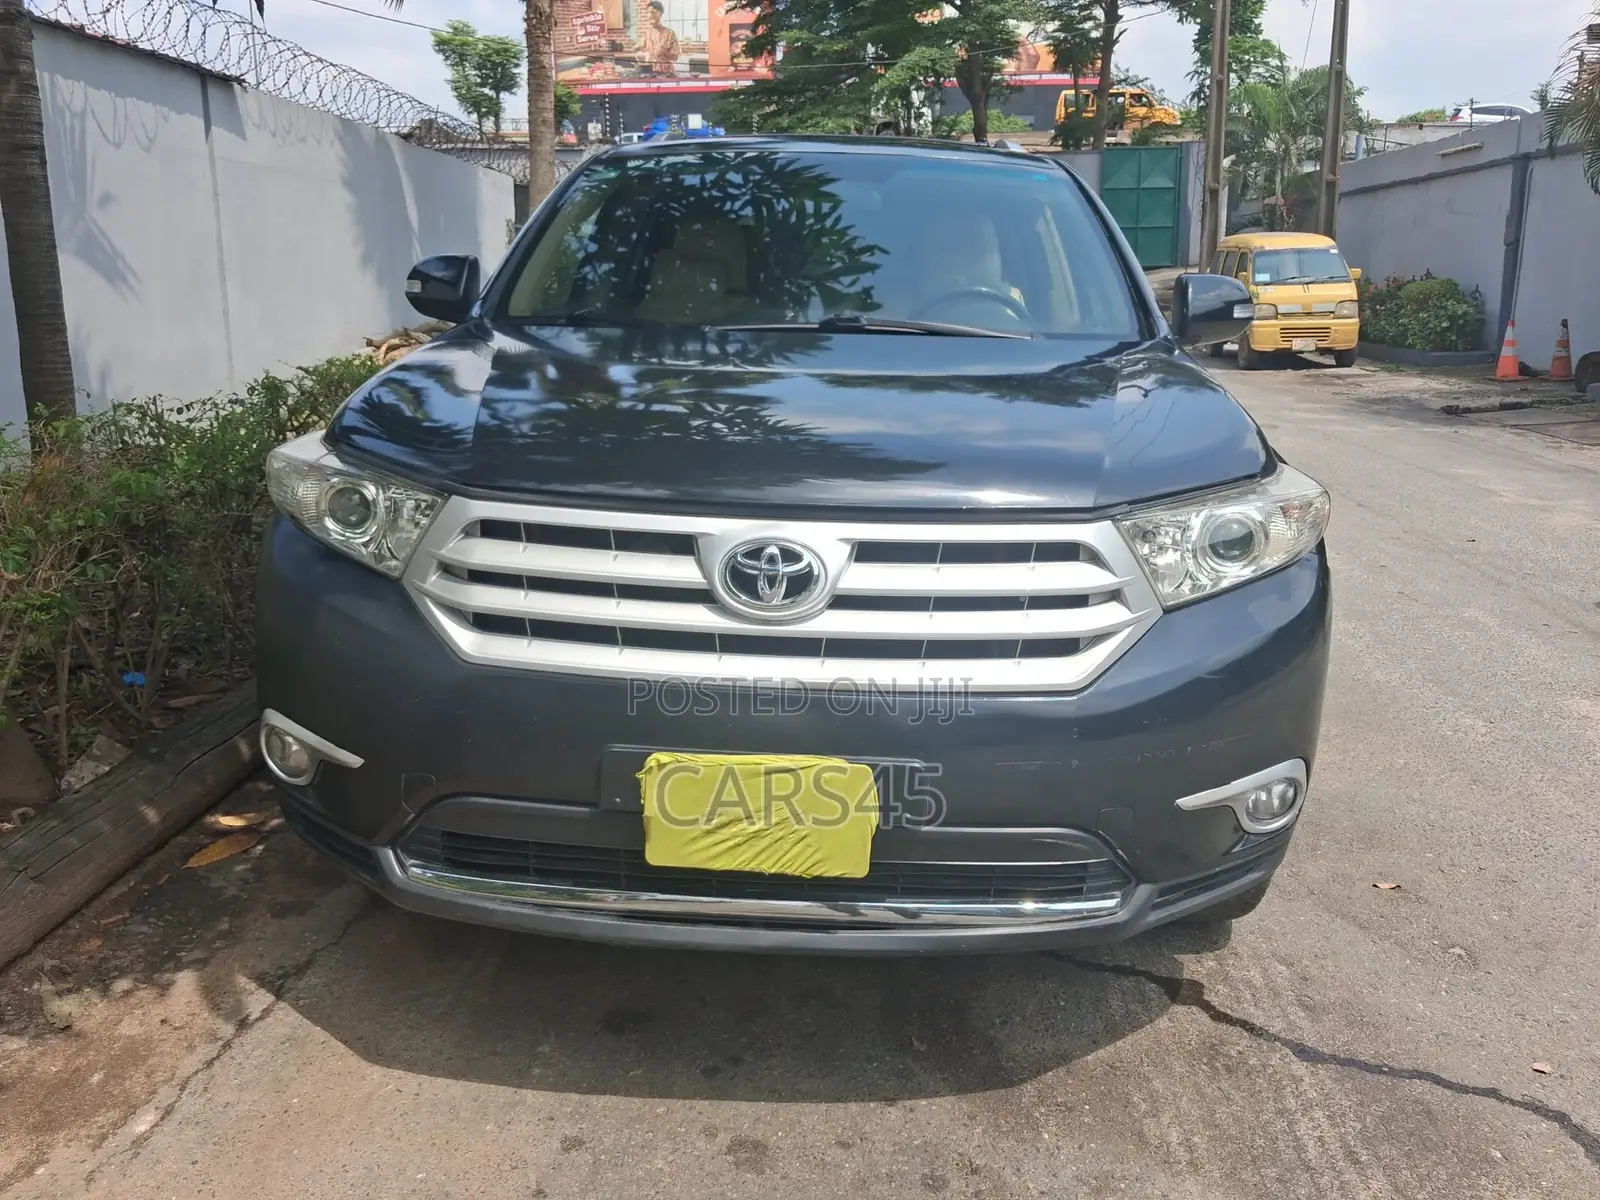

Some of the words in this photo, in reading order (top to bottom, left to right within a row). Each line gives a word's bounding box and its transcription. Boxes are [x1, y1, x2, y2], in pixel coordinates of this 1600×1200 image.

[572, 13, 602, 25] Sprinkle
[586, 24, 600, 32] Stir
[577, 35, 599, 43] Serve
